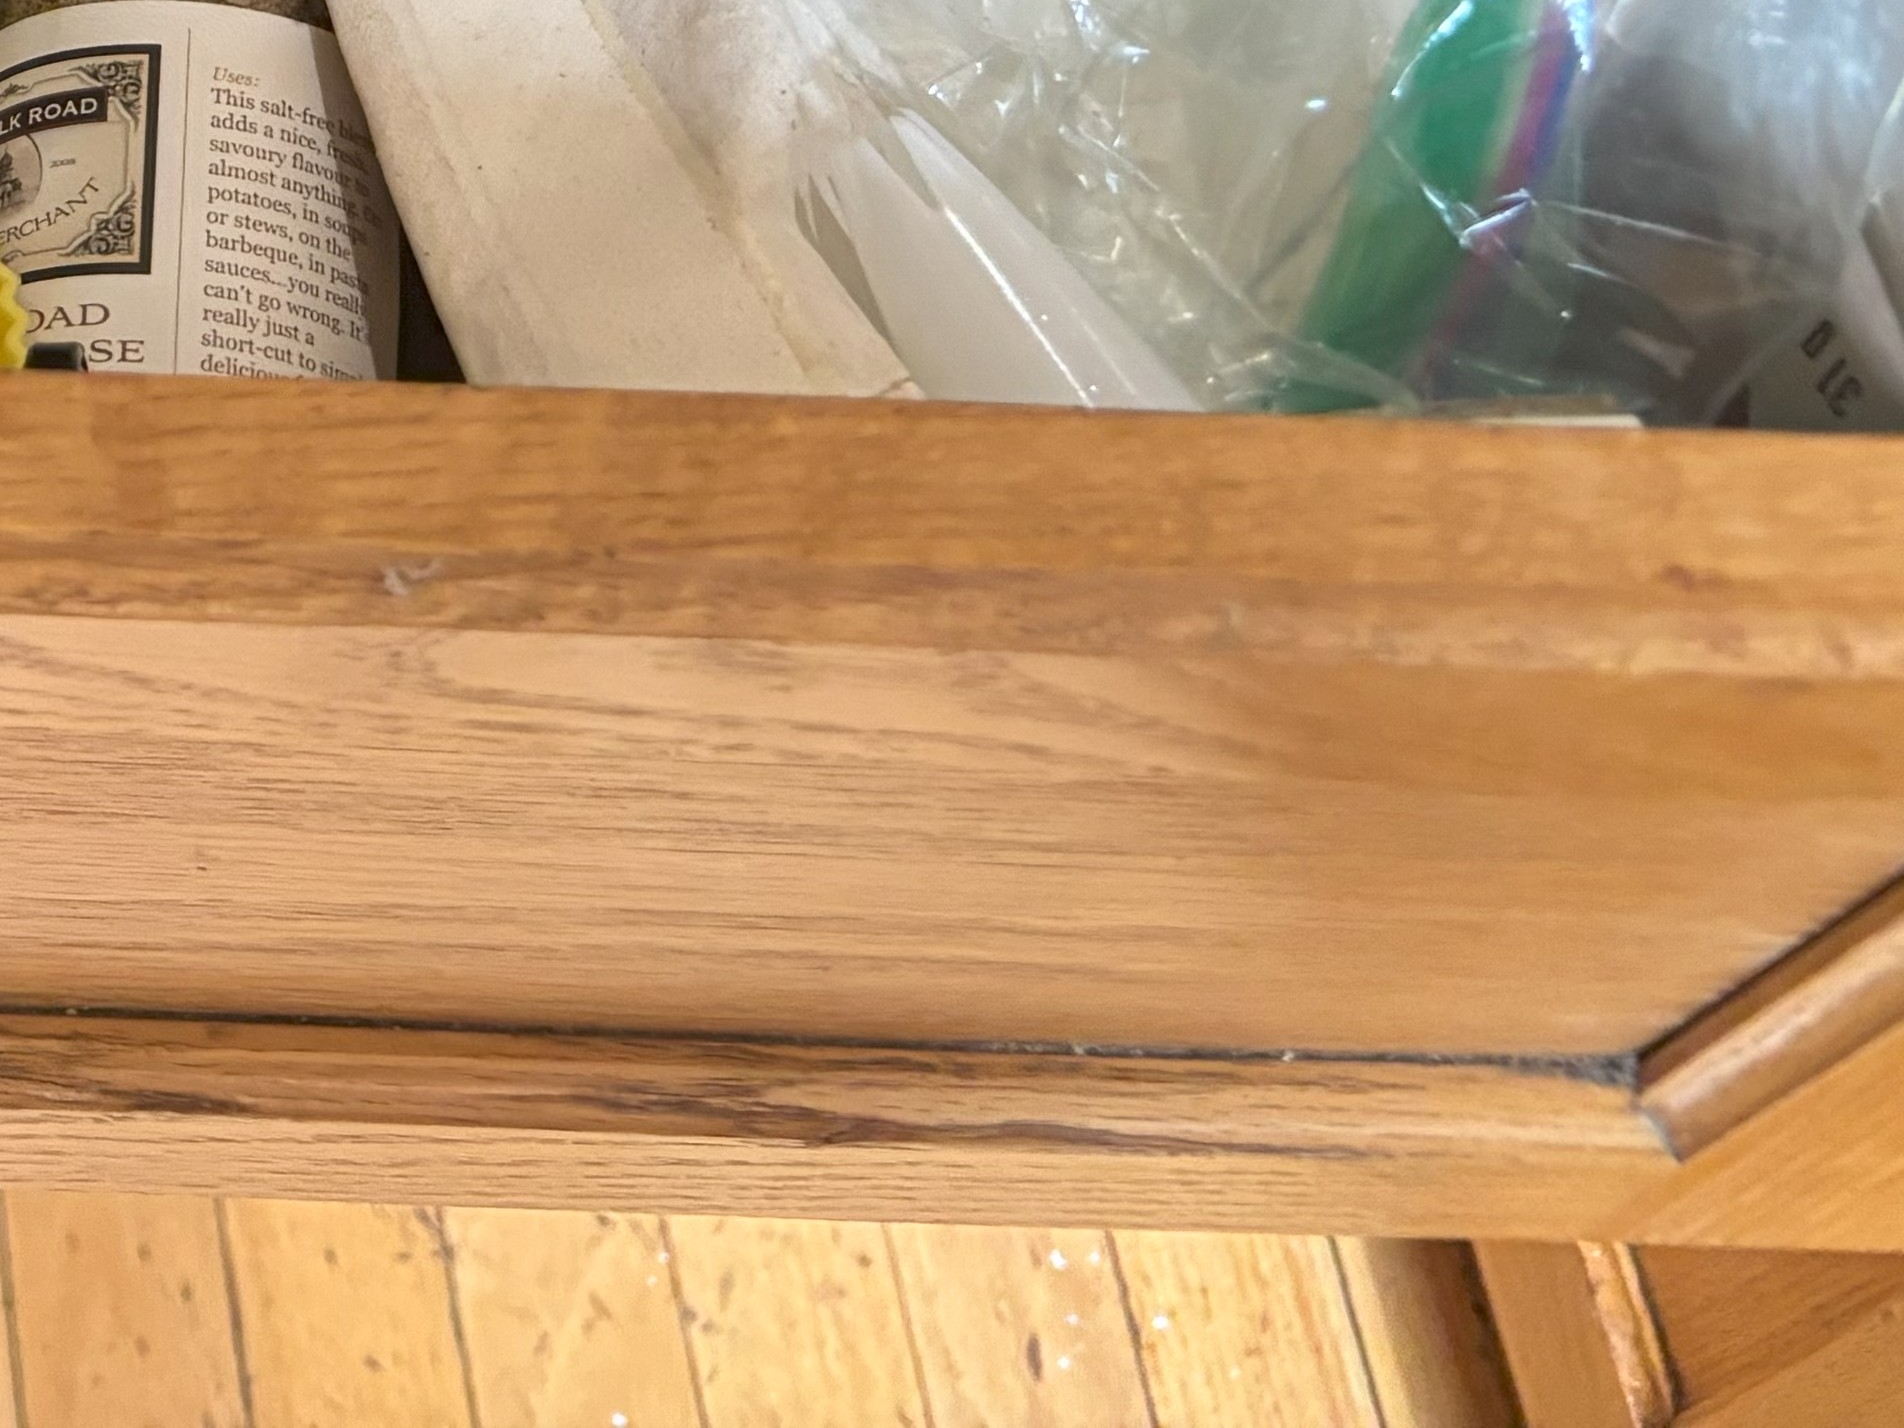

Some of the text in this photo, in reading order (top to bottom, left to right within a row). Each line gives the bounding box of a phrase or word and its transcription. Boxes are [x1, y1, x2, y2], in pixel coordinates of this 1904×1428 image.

[212, 65, 262, 88] Uses:
[28, 97, 98, 124] ROAD
[210, 87, 335, 132] This salt-free
[210, 113, 258, 135] adds
[209, 138, 288, 169] savoury
[207, 160, 277, 188] almost
[207, 184, 297, 220] potatoes,
[233, 212, 295, 243] stews,
[205, 229, 304, 272] barbeque,
[202, 306, 301, 341] really just
[201, 329, 293, 366] short-cut
